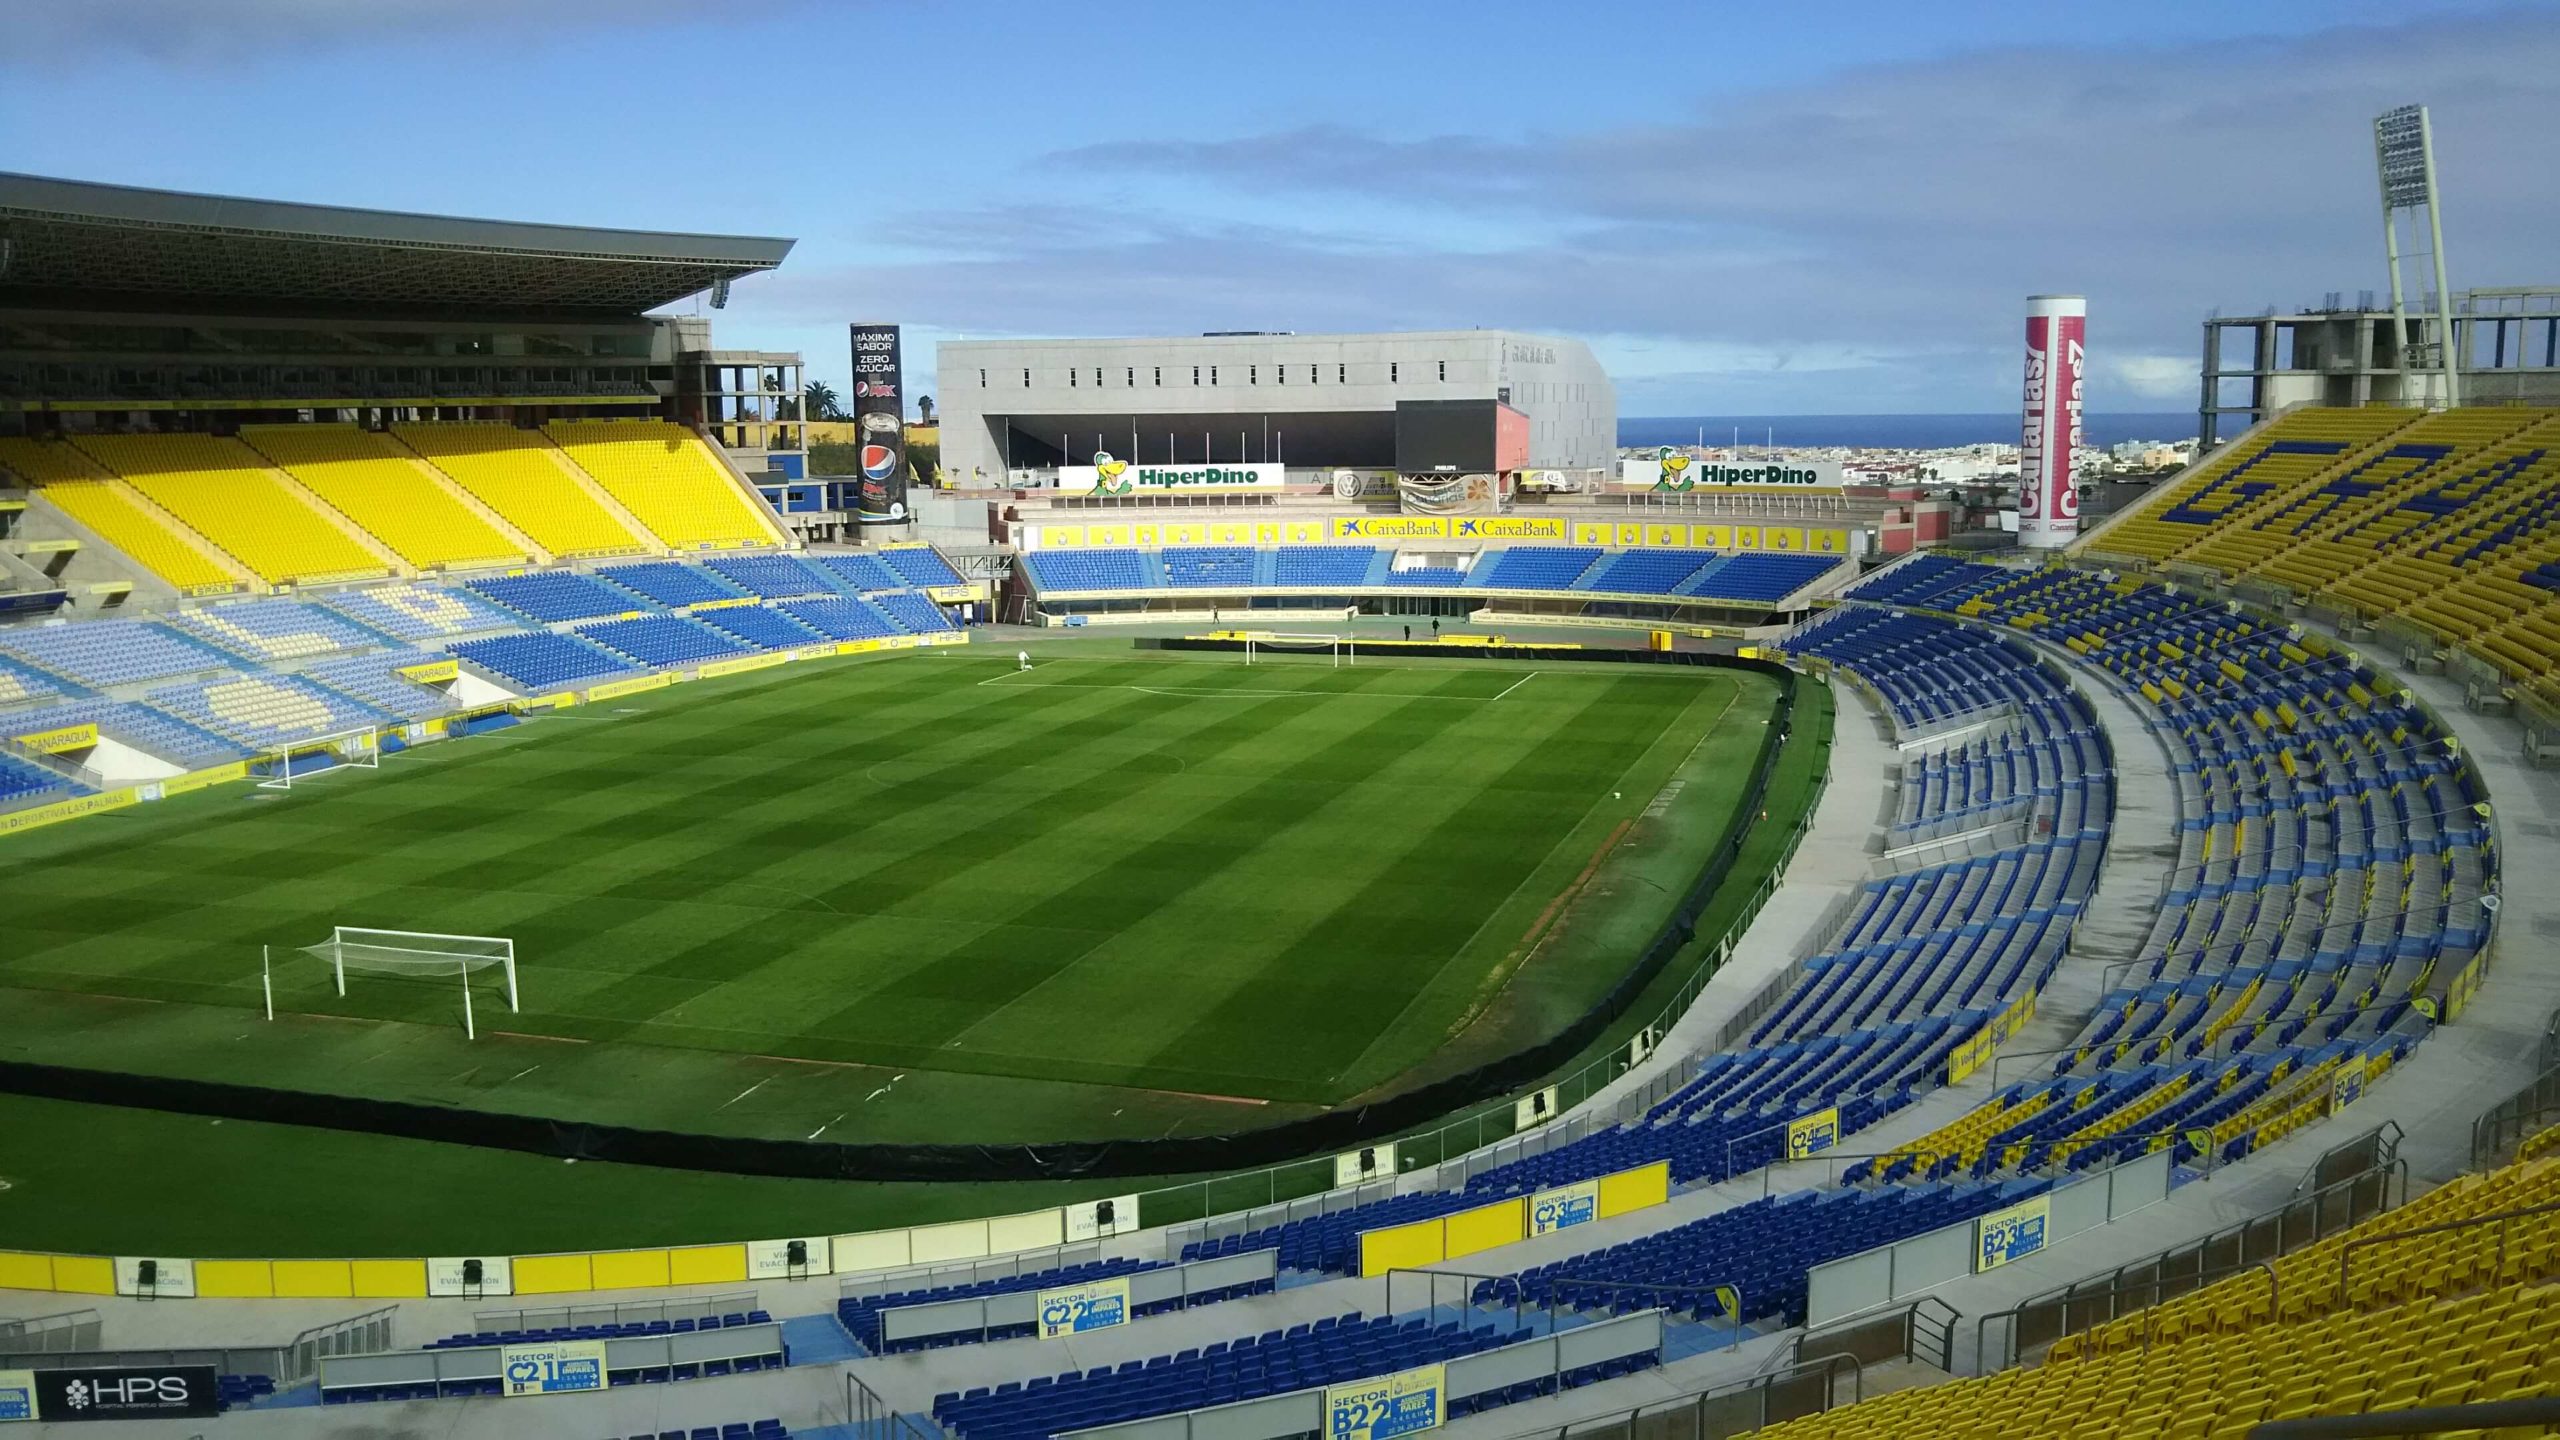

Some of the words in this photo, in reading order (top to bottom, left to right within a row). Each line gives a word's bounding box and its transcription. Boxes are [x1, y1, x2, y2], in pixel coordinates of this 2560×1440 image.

[853, 332, 895, 342] MÁXIMO
[856, 342, 892, 351] SABOR
[855, 362, 896, 373] AZÚCAR
[860, 354, 890, 364] ZERO
[1139, 468, 1259, 488] HiperDino
[1701, 465, 1817, 487] HiperDino
[1364, 520, 1440, 536] CaixaBank
[1481, 520, 1557, 537] CaixaBank
[941, 587, 970, 597] HPS
[29, 731, 91, 751] CANARAGUA
[10, 805, 66, 828] DEPORTIVA
[67, 803, 87, 815] LAS
[87, 794, 124, 810] PALMAS
[1791, 1129, 1815, 1150] C24
[1536, 1194, 1566, 1208] SECTOR
[1535, 1201, 1567, 1225] C23
[1984, 1216, 2018, 1233] SECTOR
[1983, 1225, 2018, 1257] B23
[1043, 1294, 1085, 1307] SECTOR
[1042, 1301, 1089, 1327] C22
[508, 1353, 554, 1362] SECTOR
[507, 1361, 554, 1383] C21
[92, 1376, 188, 1404] HPS
[1334, 1389, 1388, 1408] SECTOR
[1333, 1399, 1391, 1436] B22
